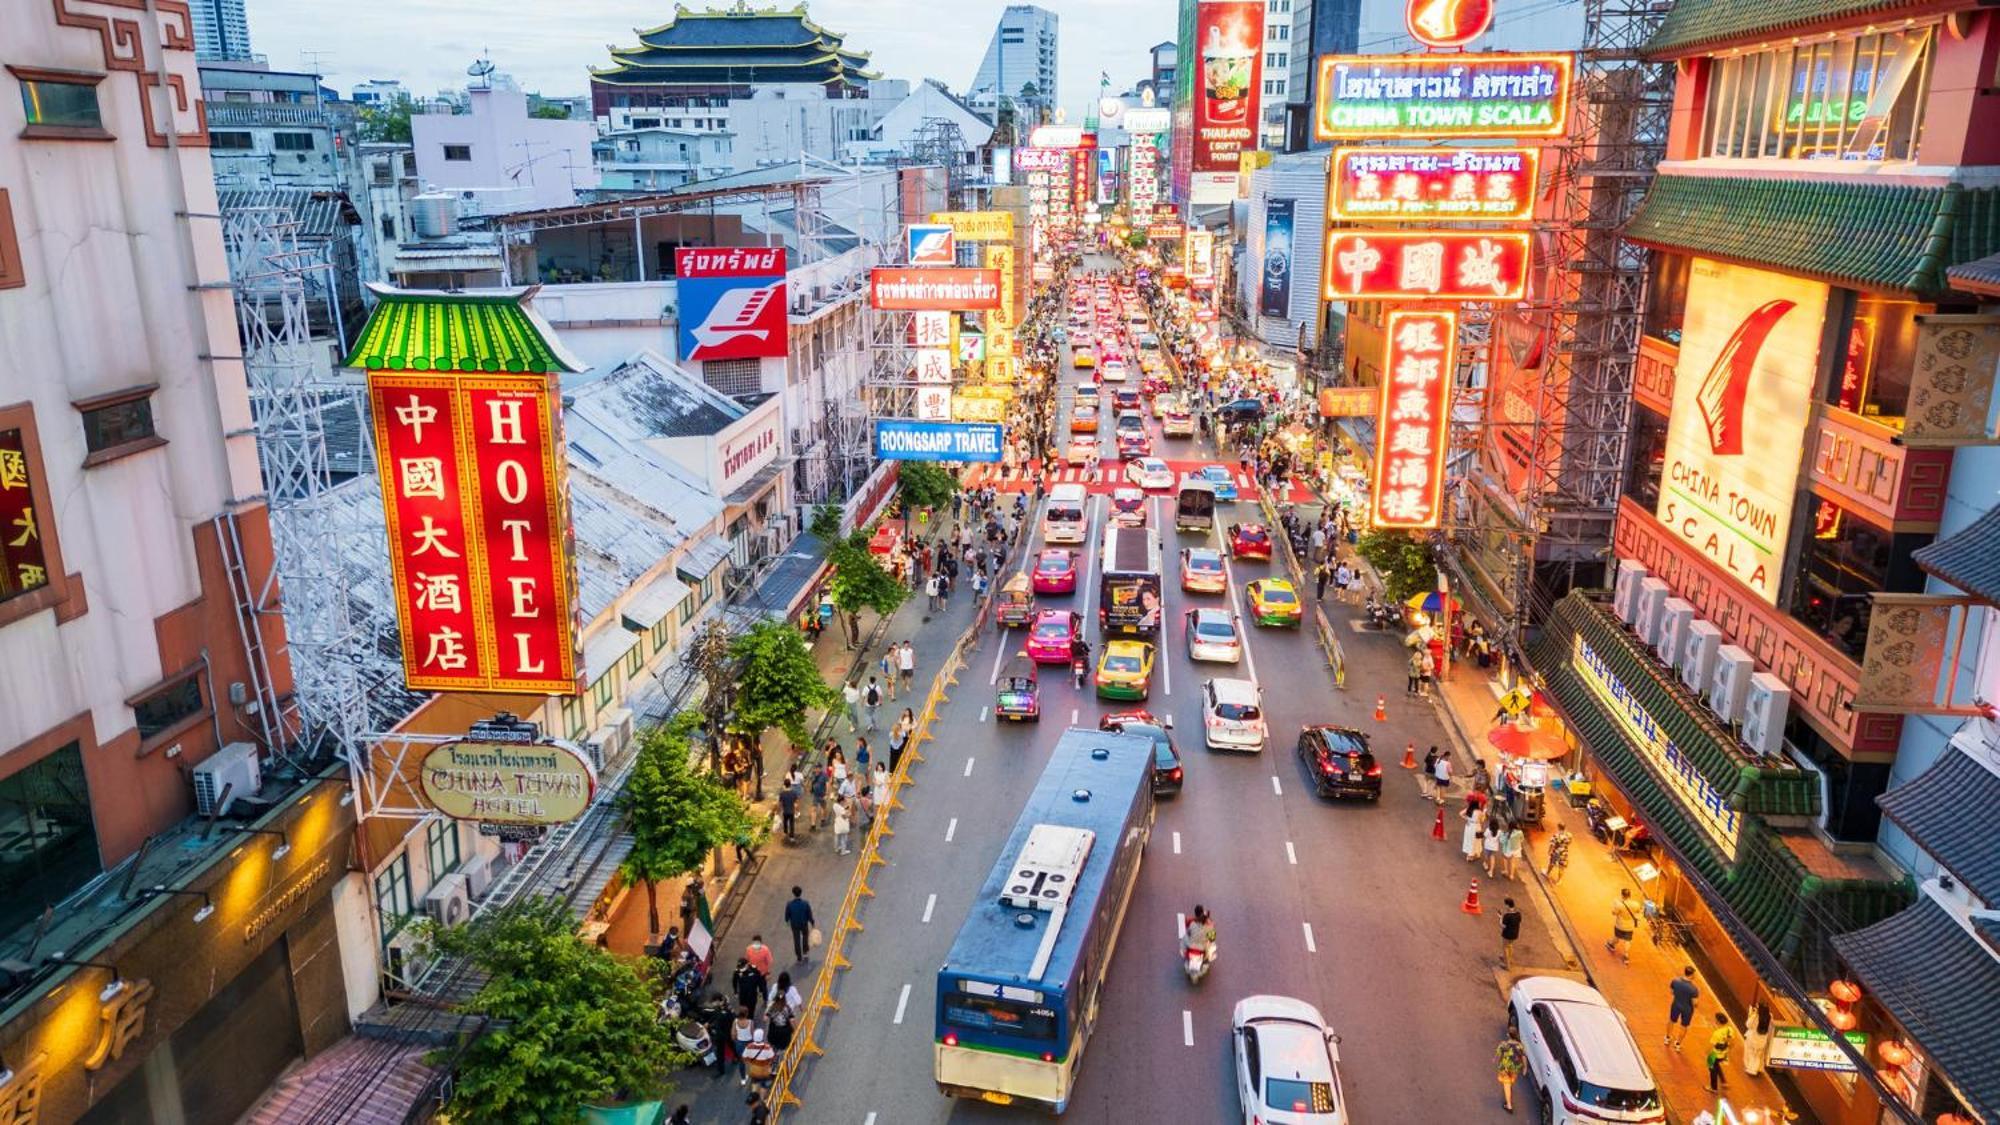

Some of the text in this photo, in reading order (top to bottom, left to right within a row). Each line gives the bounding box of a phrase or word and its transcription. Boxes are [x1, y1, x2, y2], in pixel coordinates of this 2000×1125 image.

[1331, 105, 1553, 127] CHINA TOWN SCALA
[1201, 128, 1252, 139] THAILAND
[1212, 152, 1239, 161] POWER
[682, 248, 780, 278] รุ่งทรัพย์
[1338, 237, 1508, 297] 中國城
[879, 430, 999, 453] ROONGSARP TRAVEL
[1671, 460, 1719, 505] CHINA
[1728, 492, 1777, 540] TOWN
[394, 393, 468, 671] 中國大酒店
[485, 399, 545, 674] HOTEL
[1664, 503, 1767, 590] SCALA
[431, 768, 582, 799] CHINA TOWN
[473, 797, 545, 817] HOTEL
[994, 984, 1005, 999] 4
